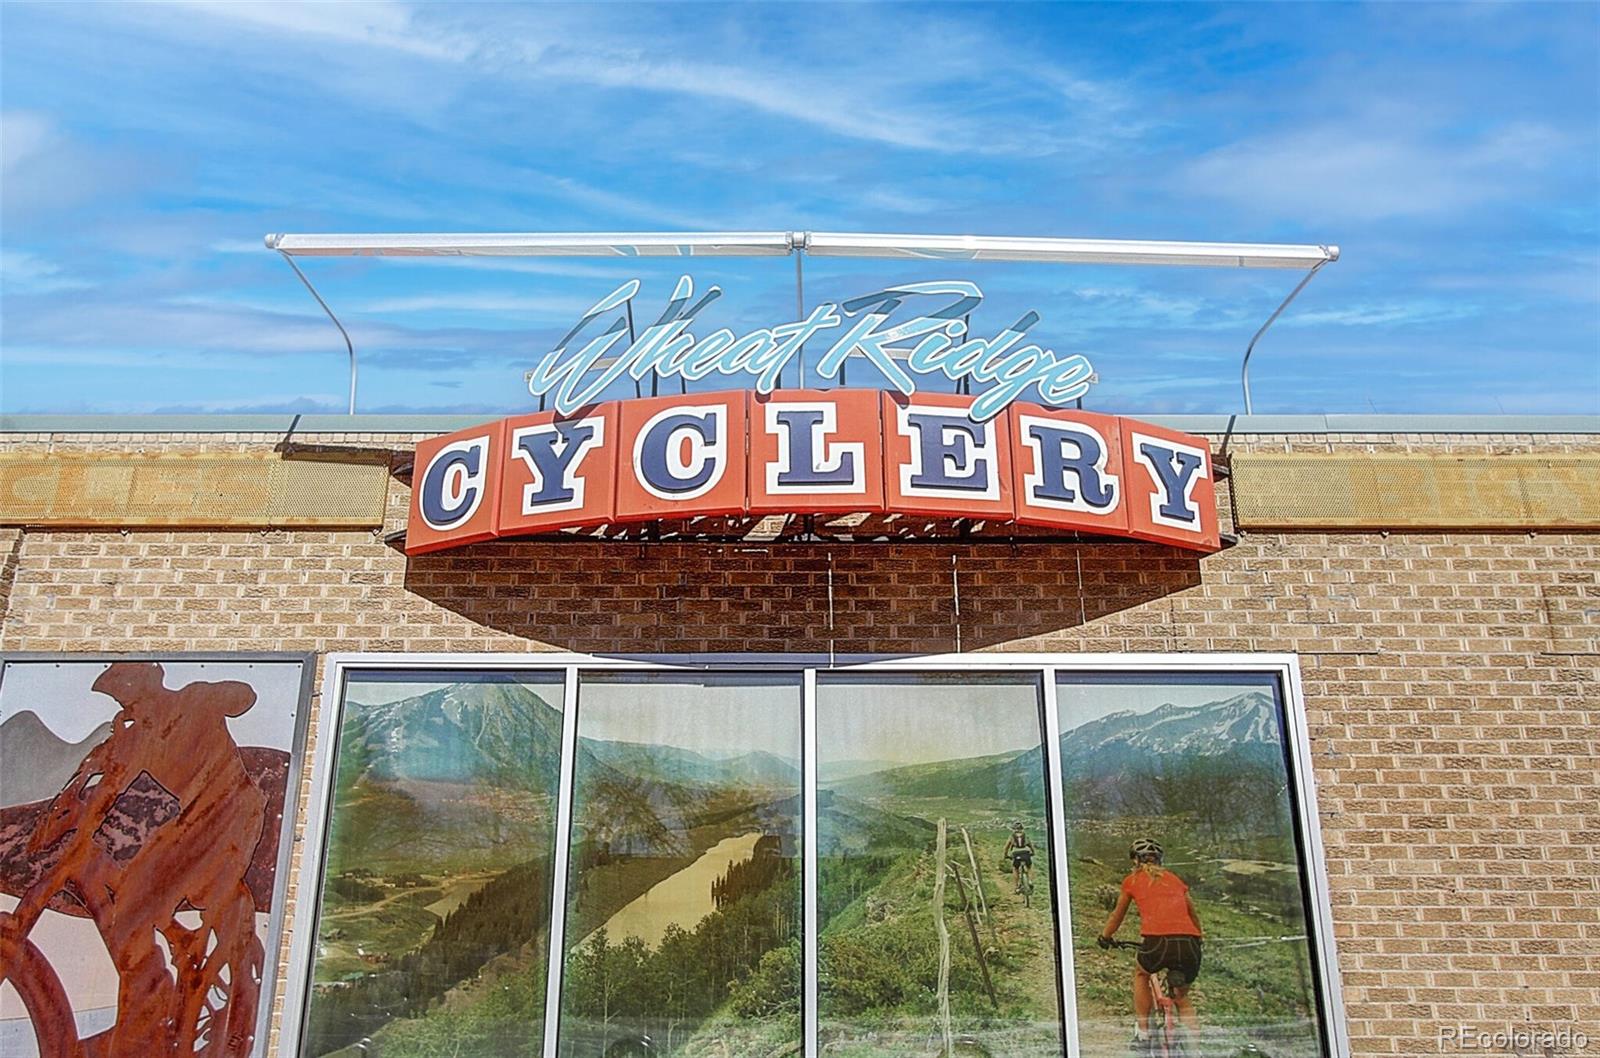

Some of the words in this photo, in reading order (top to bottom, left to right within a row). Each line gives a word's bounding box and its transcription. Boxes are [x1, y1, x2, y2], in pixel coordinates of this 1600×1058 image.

[529, 274, 840, 416] Wheat
[816, 280, 1094, 422] Ridge
[419, 402, 1208, 533] CYCLERY
